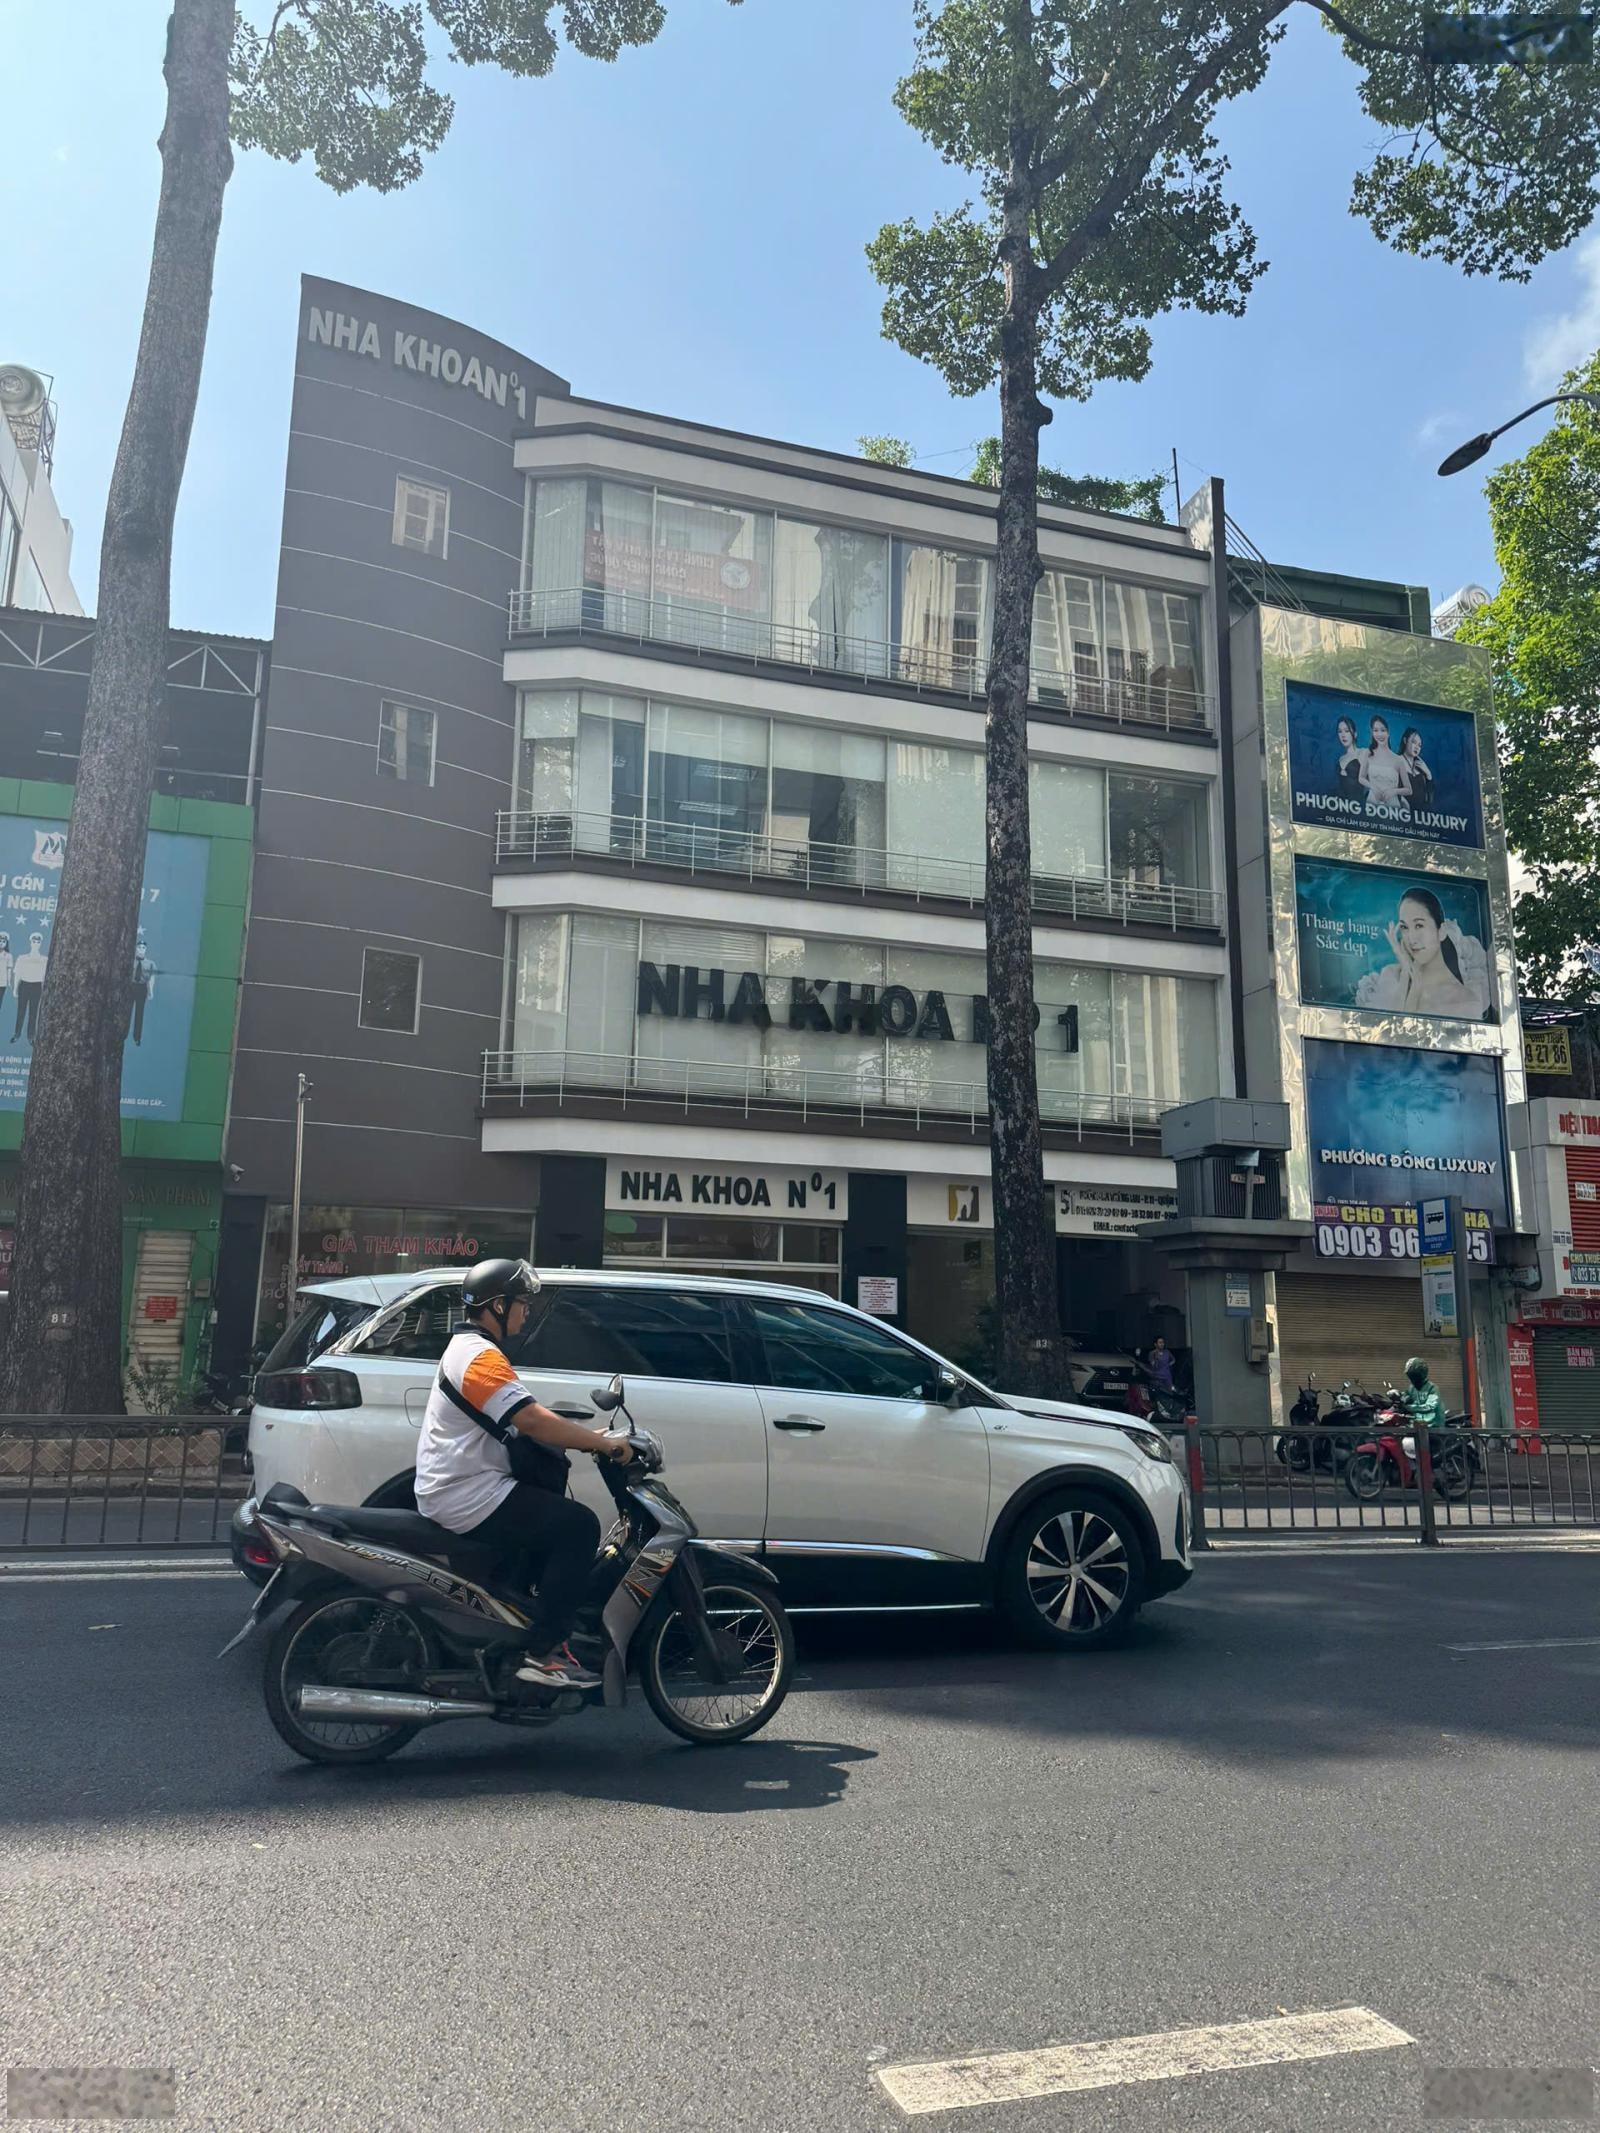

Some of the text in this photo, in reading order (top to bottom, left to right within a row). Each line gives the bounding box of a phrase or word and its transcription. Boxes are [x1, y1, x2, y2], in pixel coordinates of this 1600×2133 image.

[308, 306, 381, 360] NHA
[1295, 792, 1361, 815] PHƯƠNG
[1414, 810, 1468, 832] LUXURY
[7, 895, 57, 915] NGHIỆ
[1348, 918, 1380, 939] hạng
[637, 961, 773, 1027] NHA
[788, 976, 955, 1042] KHOA
[1321, 1149, 1497, 1174] PHƯƠNG ĐÔNG LUXURY
[620, 1170, 683, 1203] NHA
[691, 1174, 771, 1207] KHOA
[1341, 1206, 1385, 1224] CHO
[1391, 1208, 1418, 1225] TH
[1464, 1210, 1491, 1229] HÀ
[363, 1235, 419, 1255] THAM
[424, 1231, 479, 1256] KHẢO
[1318, 1224, 1382, 1256] 0903
[1389, 1227, 1421, 1258] 96
